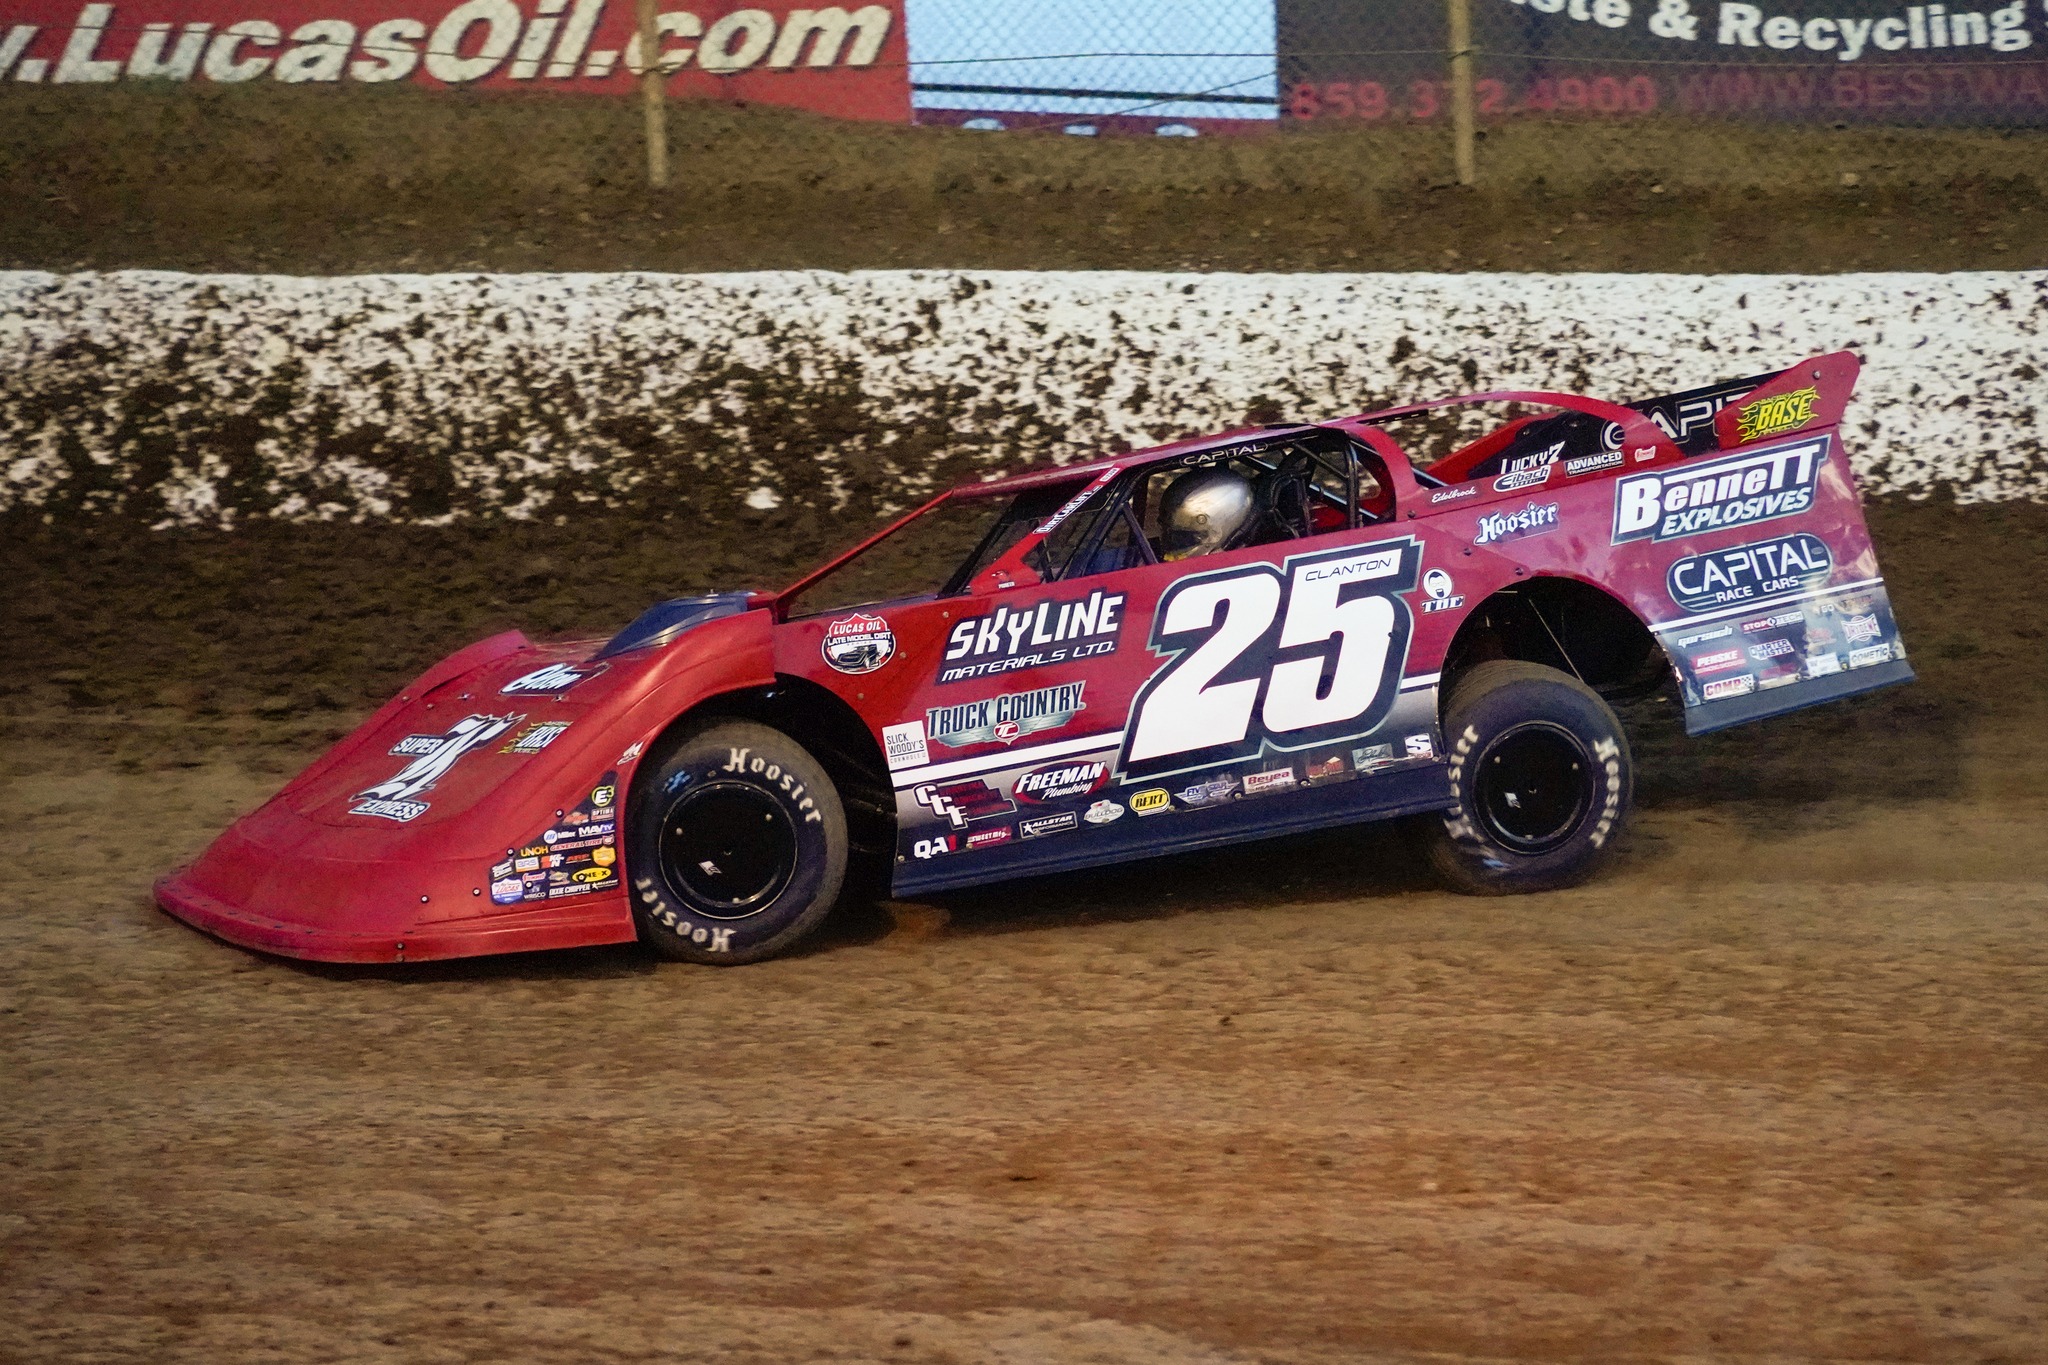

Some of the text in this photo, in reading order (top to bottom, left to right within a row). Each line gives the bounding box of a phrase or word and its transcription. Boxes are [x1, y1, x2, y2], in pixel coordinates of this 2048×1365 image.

[1649, 0, 1699, 41] &
[1717, 0, 2032, 61] Recycling
[1756, 394, 1813, 430] BASE
[1183, 444, 1265, 465] CAPITAL
[1566, 452, 1622, 471] ADVANCED
[1431, 486, 1477, 503] Edelbrock
[1661, 486, 1812, 536] EXPLOSIVES
[1477, 504, 1558, 543] Hoosier
[1305, 558, 1392, 581] CLANTON
[1673, 538, 1829, 595] CAPITAL
[1715, 576, 1799, 603] RACE CARS
[833, 620, 882, 635] LUCAS OIL
[827, 636, 846, 646] LATE
[847, 633, 873, 642] MODEL
[941, 641, 1116, 682] MATERIALS LTD.
[1129, 549, 1402, 762] 25
[1706, 678, 1741, 696] COMP
[928, 682, 1083, 738] TRUCK COUNTRY
[886, 732, 909, 745] SLICK
[998, 723, 1016, 738] TC
[393, 737, 445, 754] SUPER
[888, 739, 925, 755] WOODY'S
[723, 748, 821, 822] Hoosier
[1015, 761, 1107, 794] FREEMAN
[1248, 770, 1290, 785] Beyea
[1041, 780, 1093, 800] Plumbing
[359, 799, 426, 819] EXPRESS
[1135, 793, 1166, 808] BERT
[1031, 815, 1073, 827] ALLSTAR
[520, 846, 549, 857] UNOH
[914, 835, 957, 859] QA1
[635, 878, 736, 952] Hoosier
